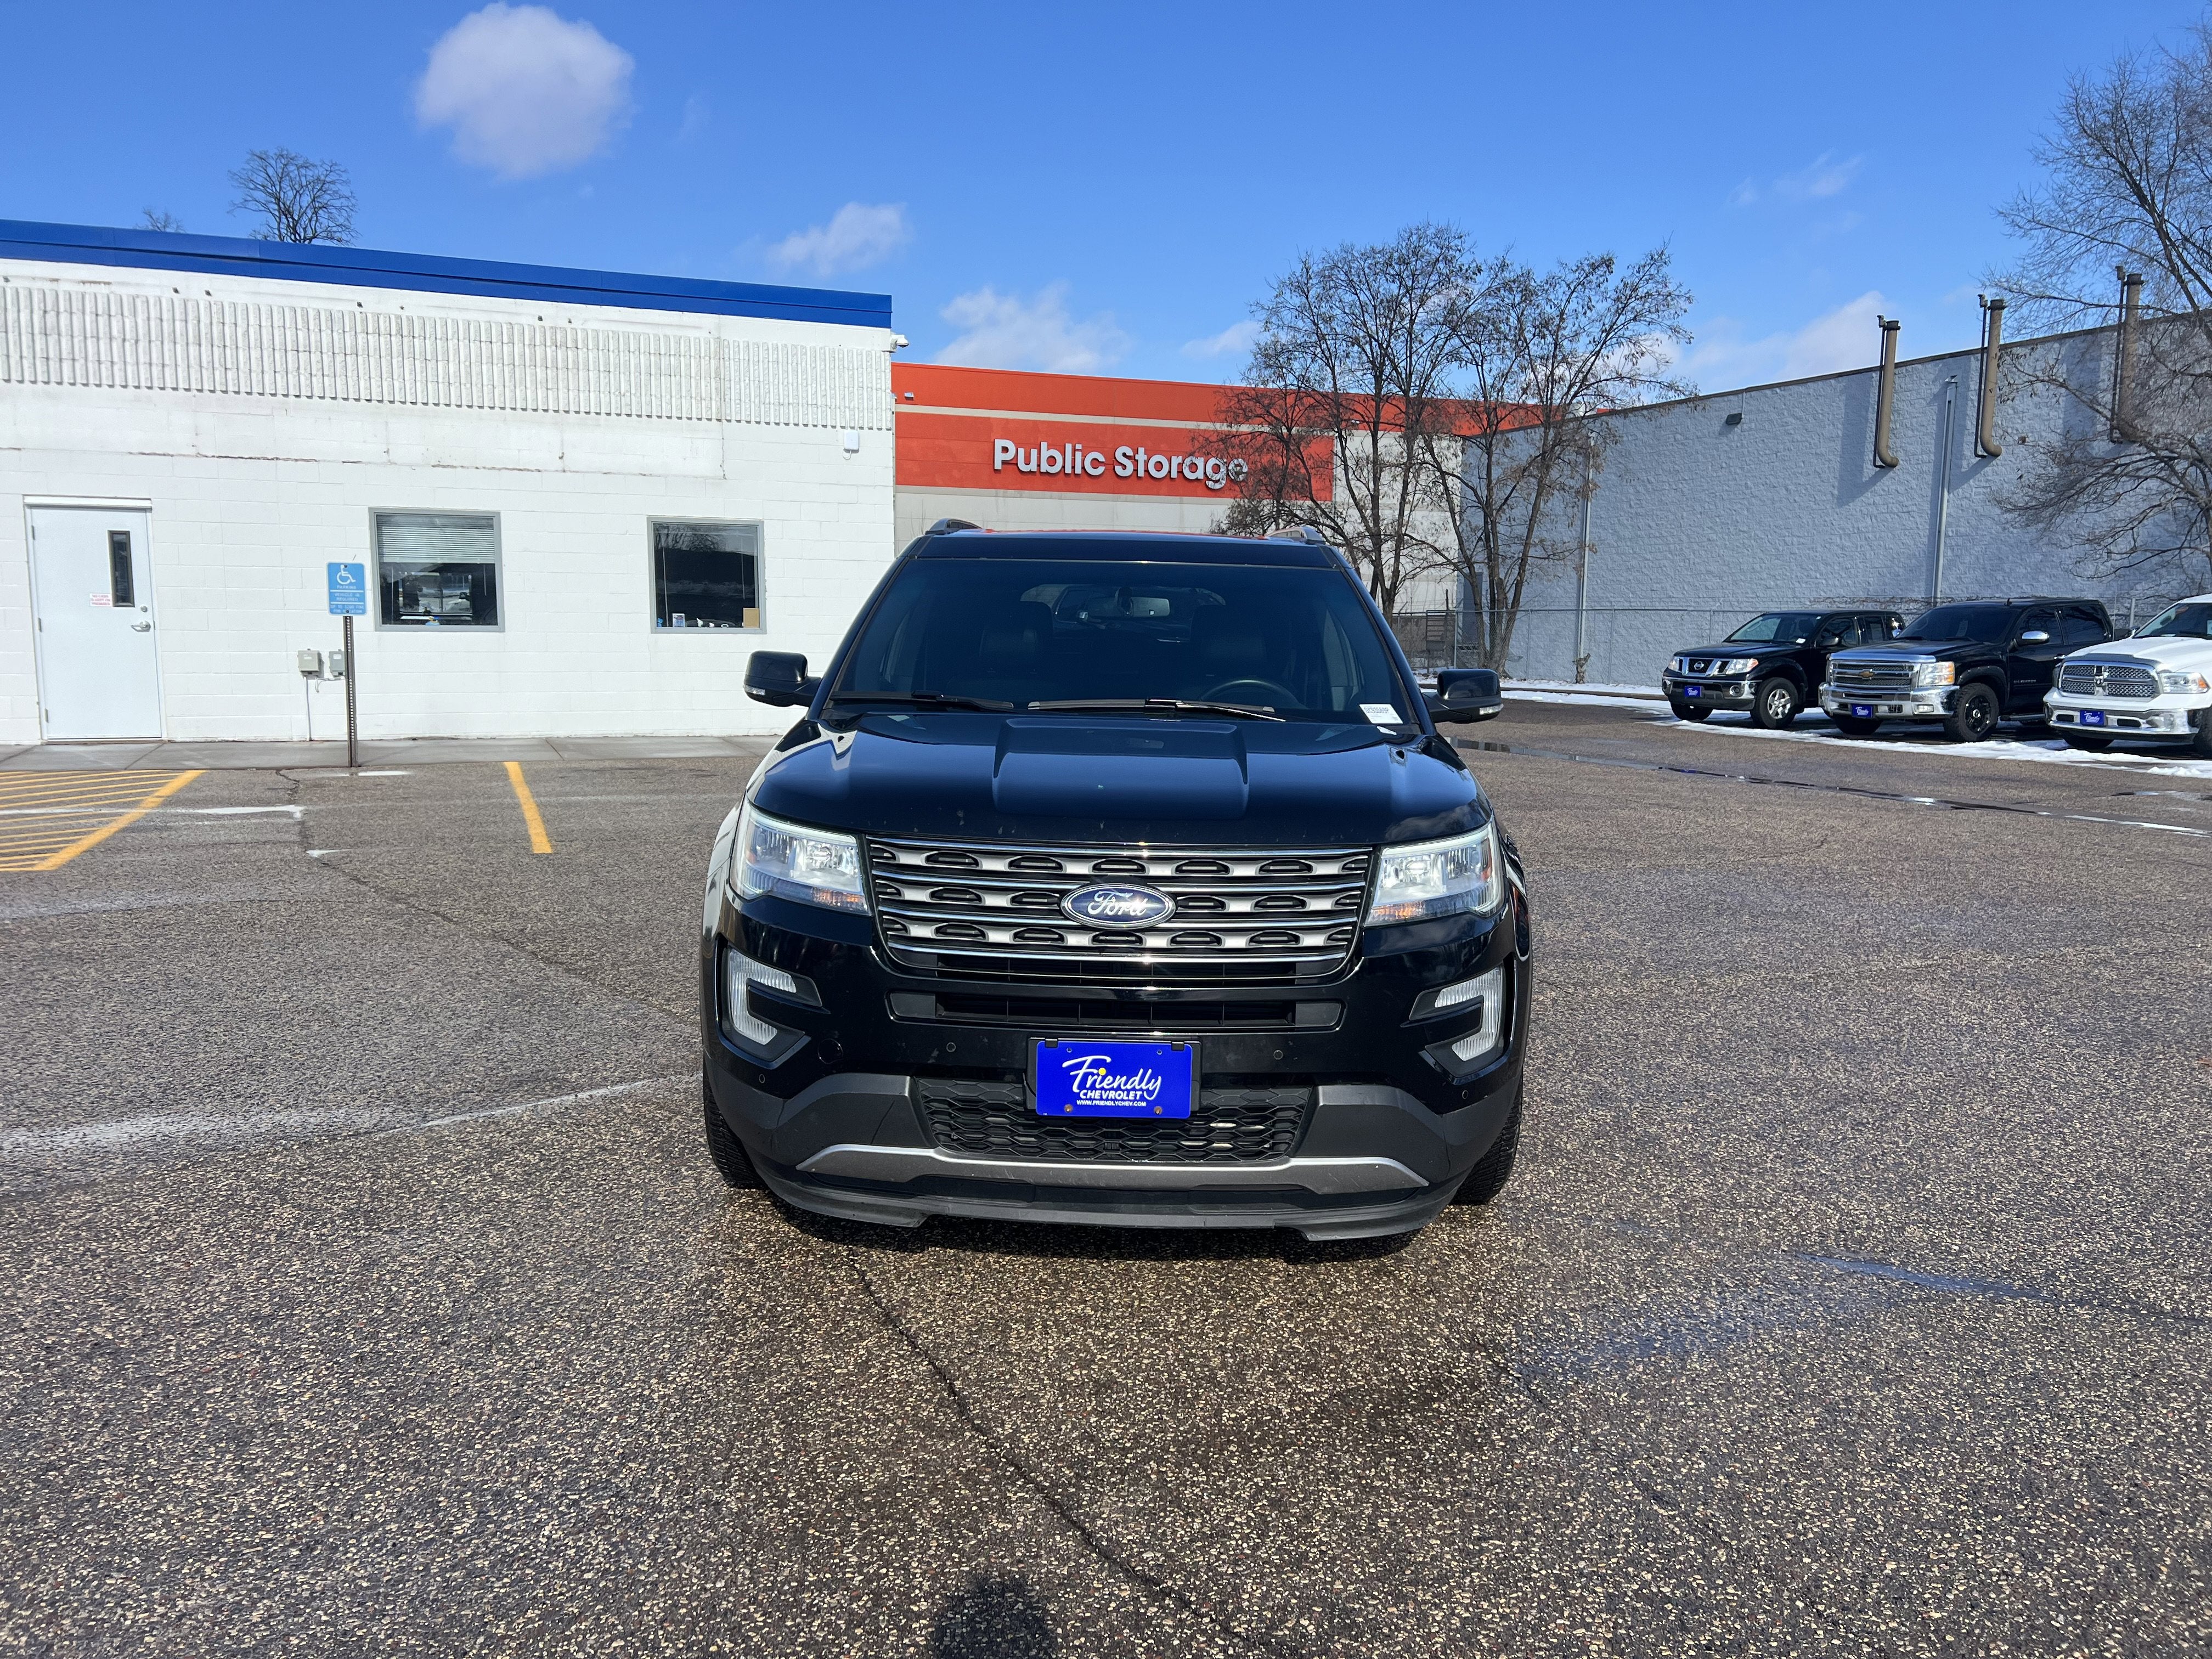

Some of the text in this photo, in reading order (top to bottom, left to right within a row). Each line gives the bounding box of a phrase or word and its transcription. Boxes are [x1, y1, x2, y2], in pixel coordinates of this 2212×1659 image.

[994, 438, 1248, 489] Public Storage
[1087, 890, 1148, 916] Ford
[1062, 1055, 1162, 1101] Friendly
[1079, 1090, 1143, 1100] CHEVROLET
